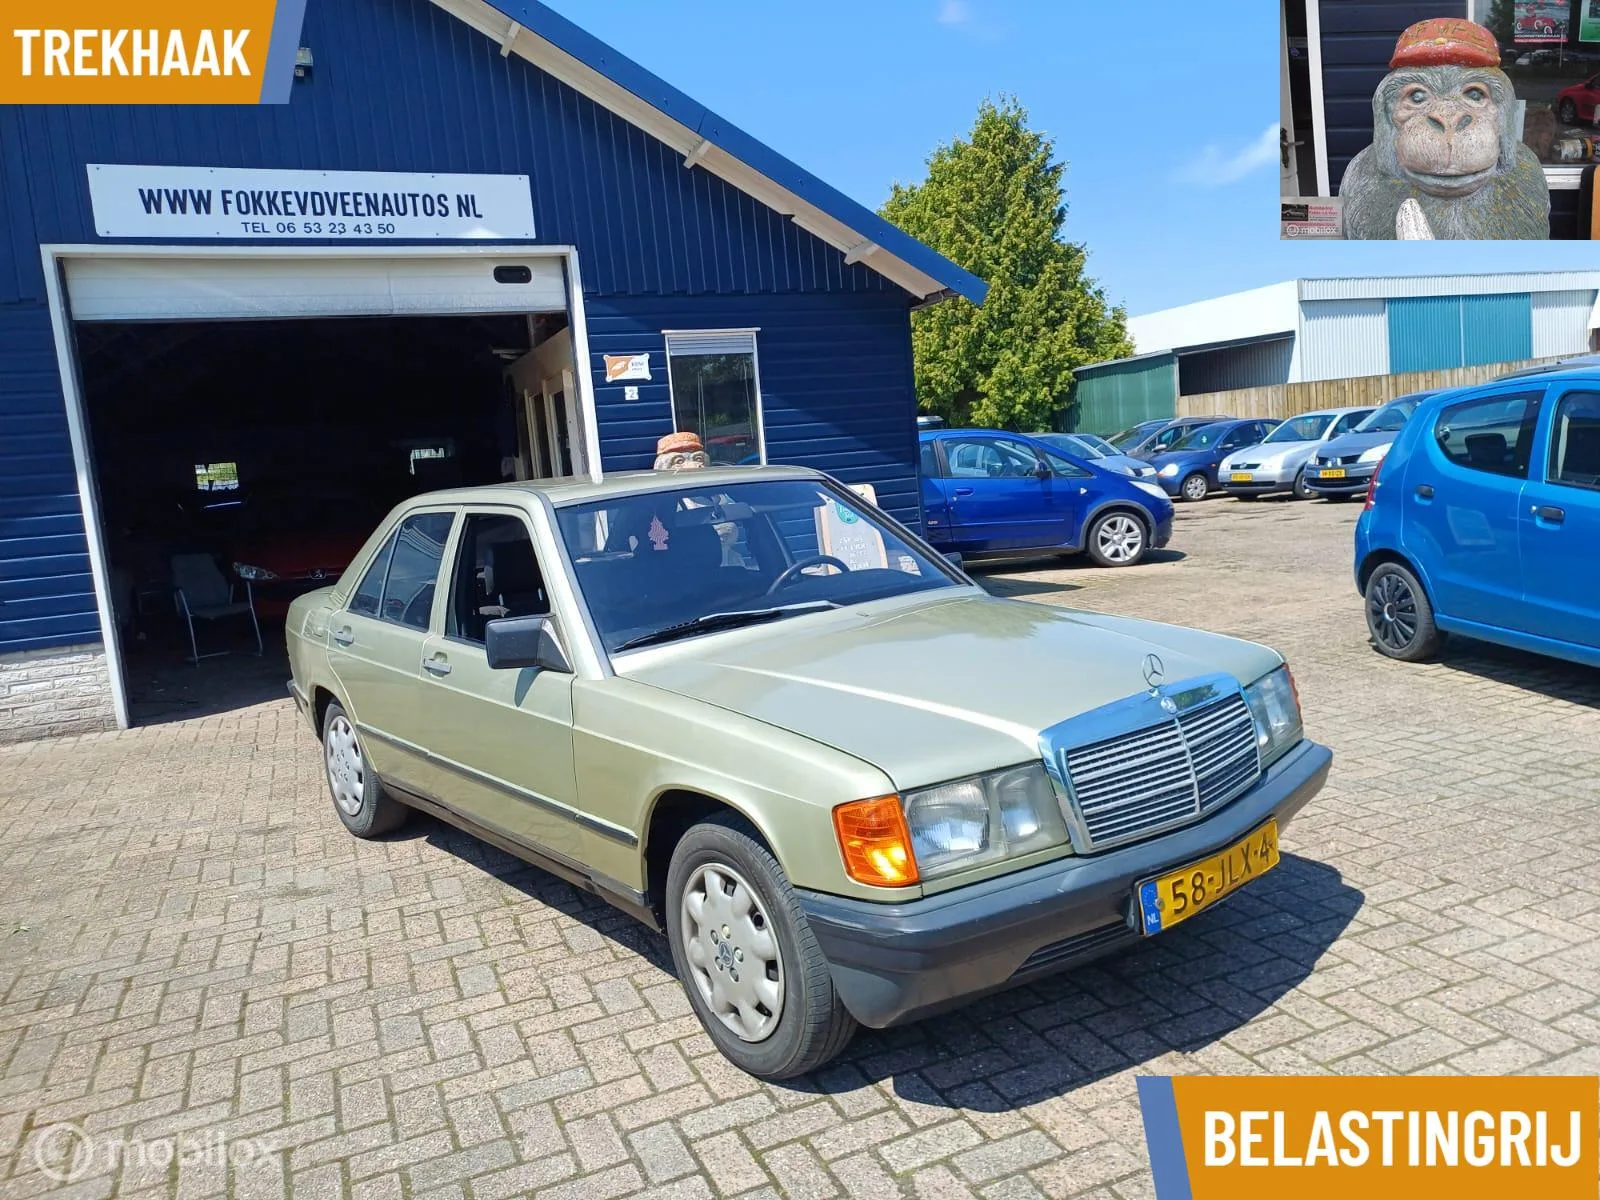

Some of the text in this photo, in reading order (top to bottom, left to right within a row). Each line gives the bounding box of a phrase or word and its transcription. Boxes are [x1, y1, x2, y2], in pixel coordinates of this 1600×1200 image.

[138, 188, 483, 219] WWW FOKKEVDVEENAUTOS NL
[241, 221, 395, 235] TEL 06 53 23 43 50
[1171, 833, 1271, 915] 58-JLX-4
[1147, 913, 1160, 926] NL
